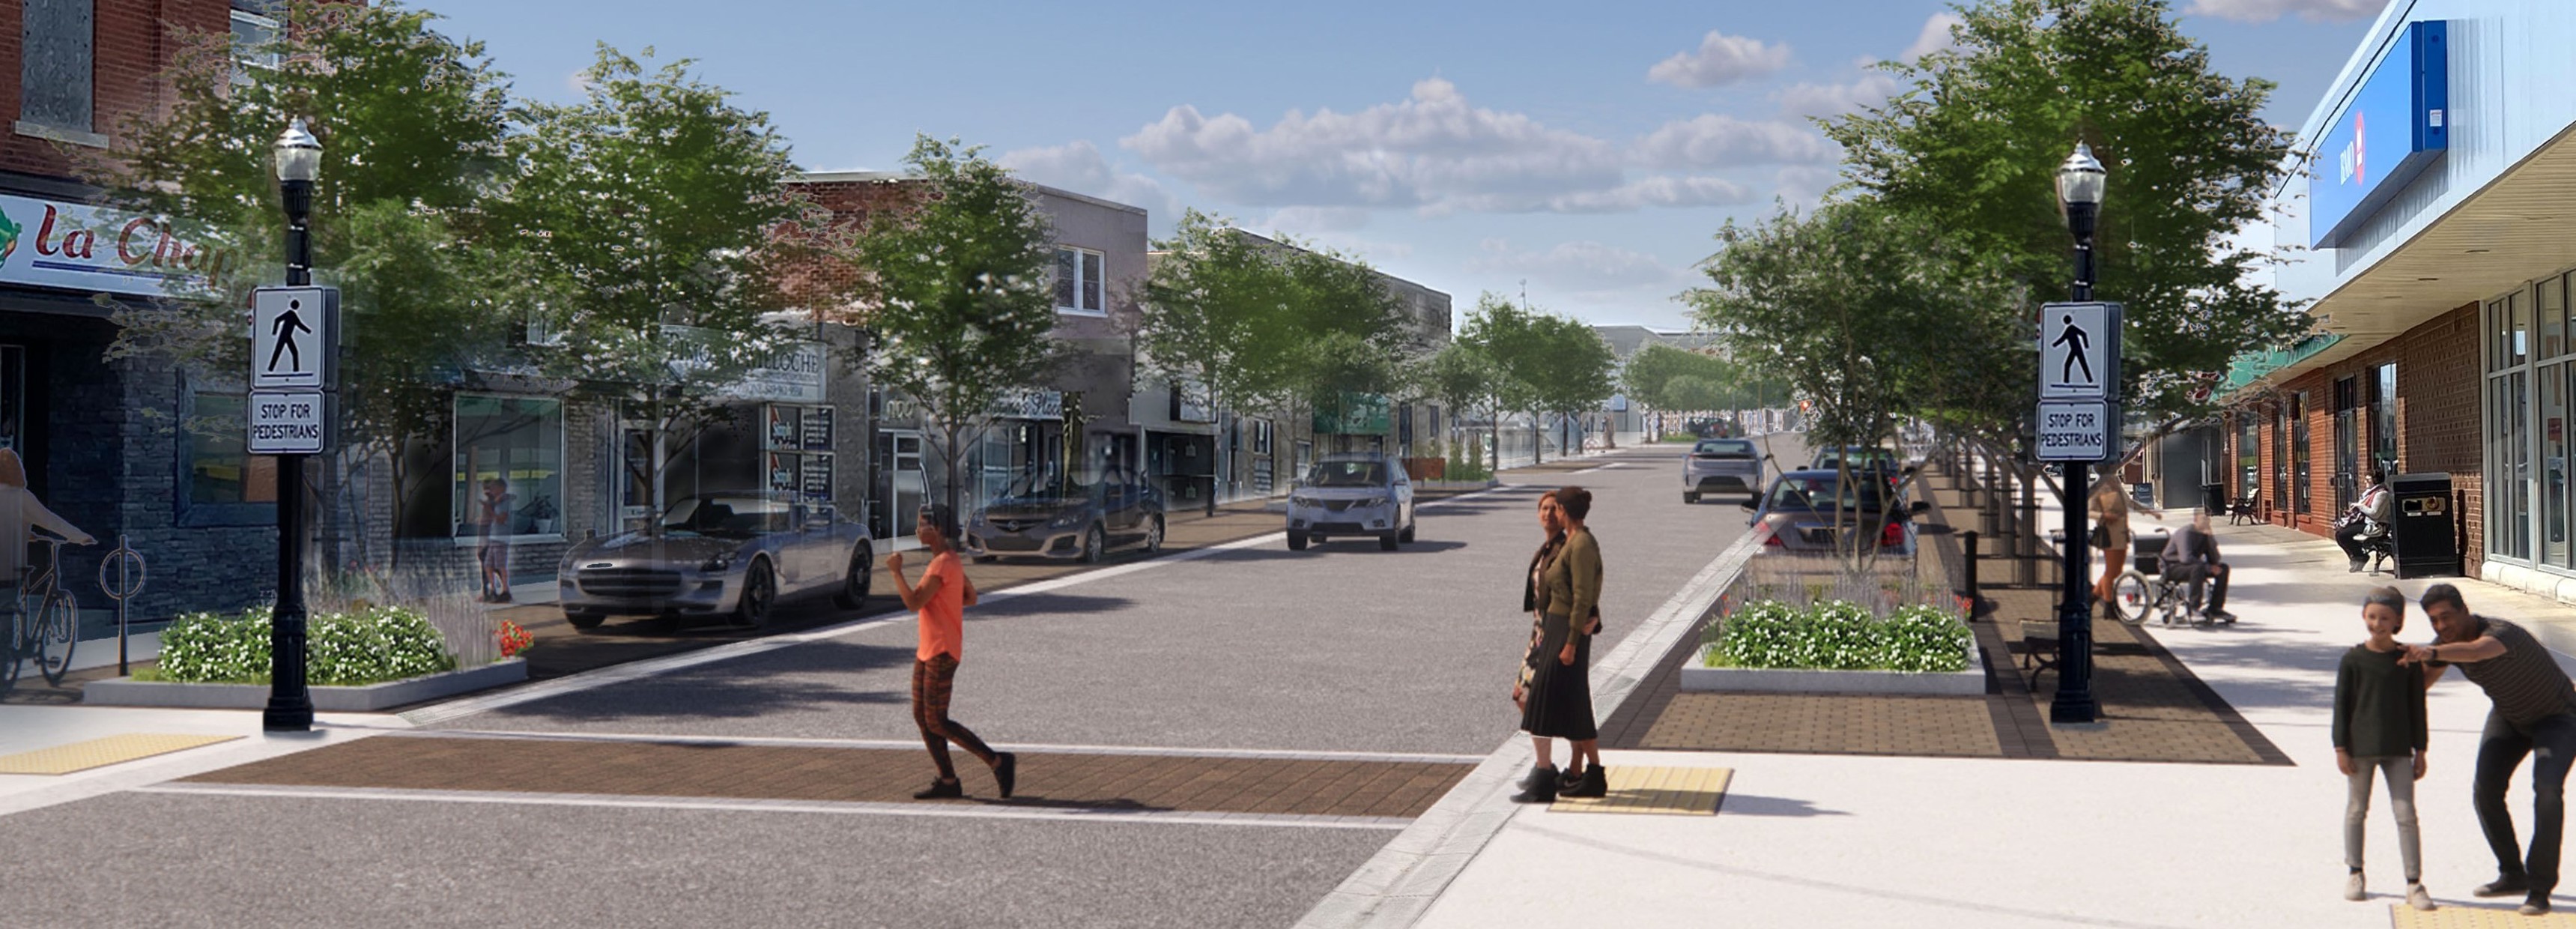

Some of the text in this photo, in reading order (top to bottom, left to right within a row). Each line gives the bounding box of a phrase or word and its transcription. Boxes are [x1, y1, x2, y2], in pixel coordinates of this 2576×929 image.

[261, 404, 311, 418] STOP FOR
[2048, 413, 2094, 427] STOP FOR
[253, 424, 318, 439] PEDESTRIANS
[2040, 432, 2102, 447] PEDESTRIANS
